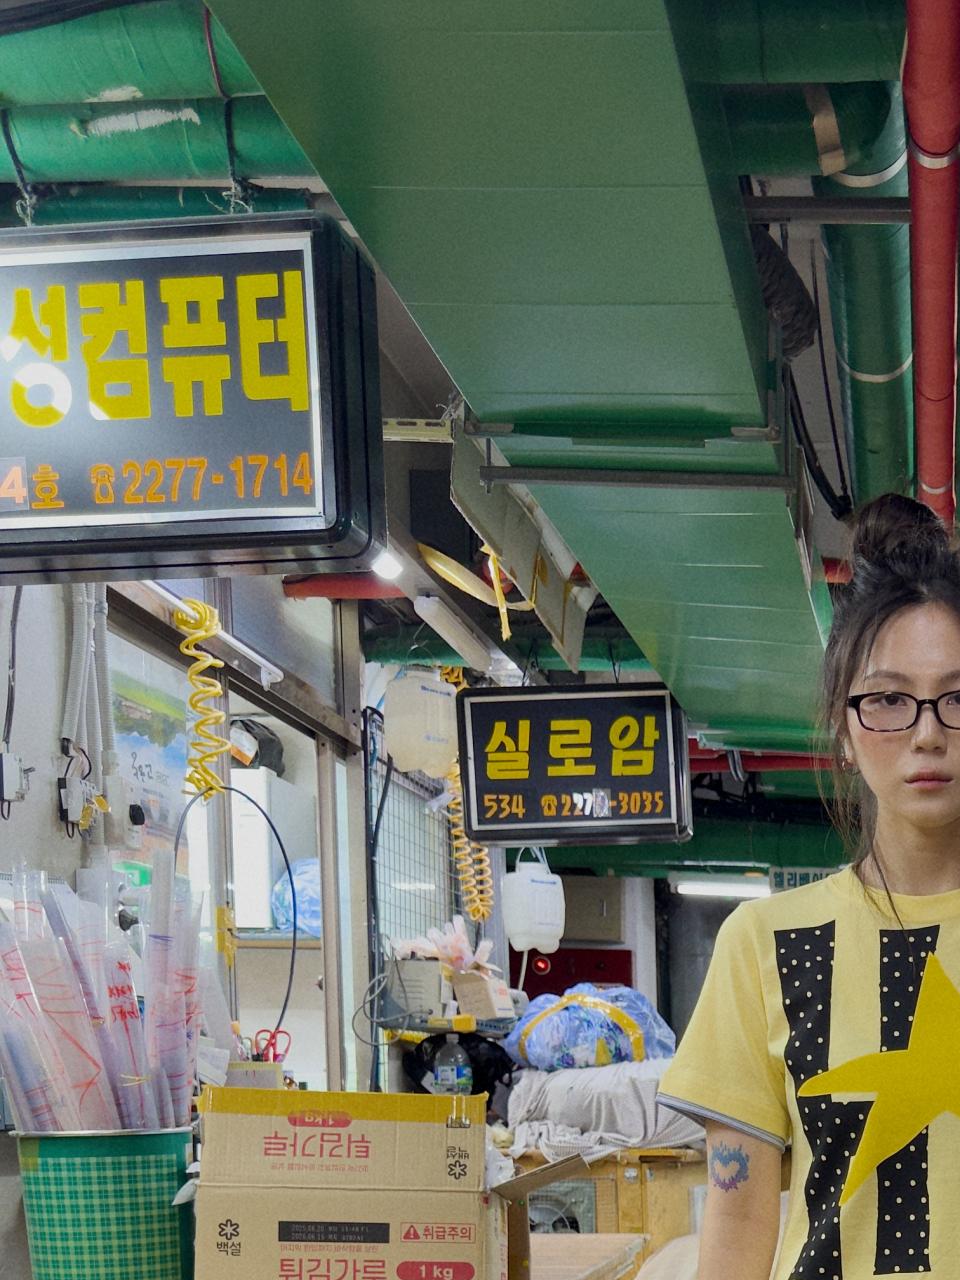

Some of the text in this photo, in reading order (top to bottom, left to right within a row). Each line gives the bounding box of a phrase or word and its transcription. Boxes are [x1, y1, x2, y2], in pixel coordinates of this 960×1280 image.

[122, 452, 313, 504] 2277-1714
[484, 714, 660, 780] 실로암
[484, 793, 526, 819] 534
[263, 1131, 372, 1159] 튀김가루
[422, 1226, 473, 1241] 취급주의
[216, 1241, 242, 1256] 백설
